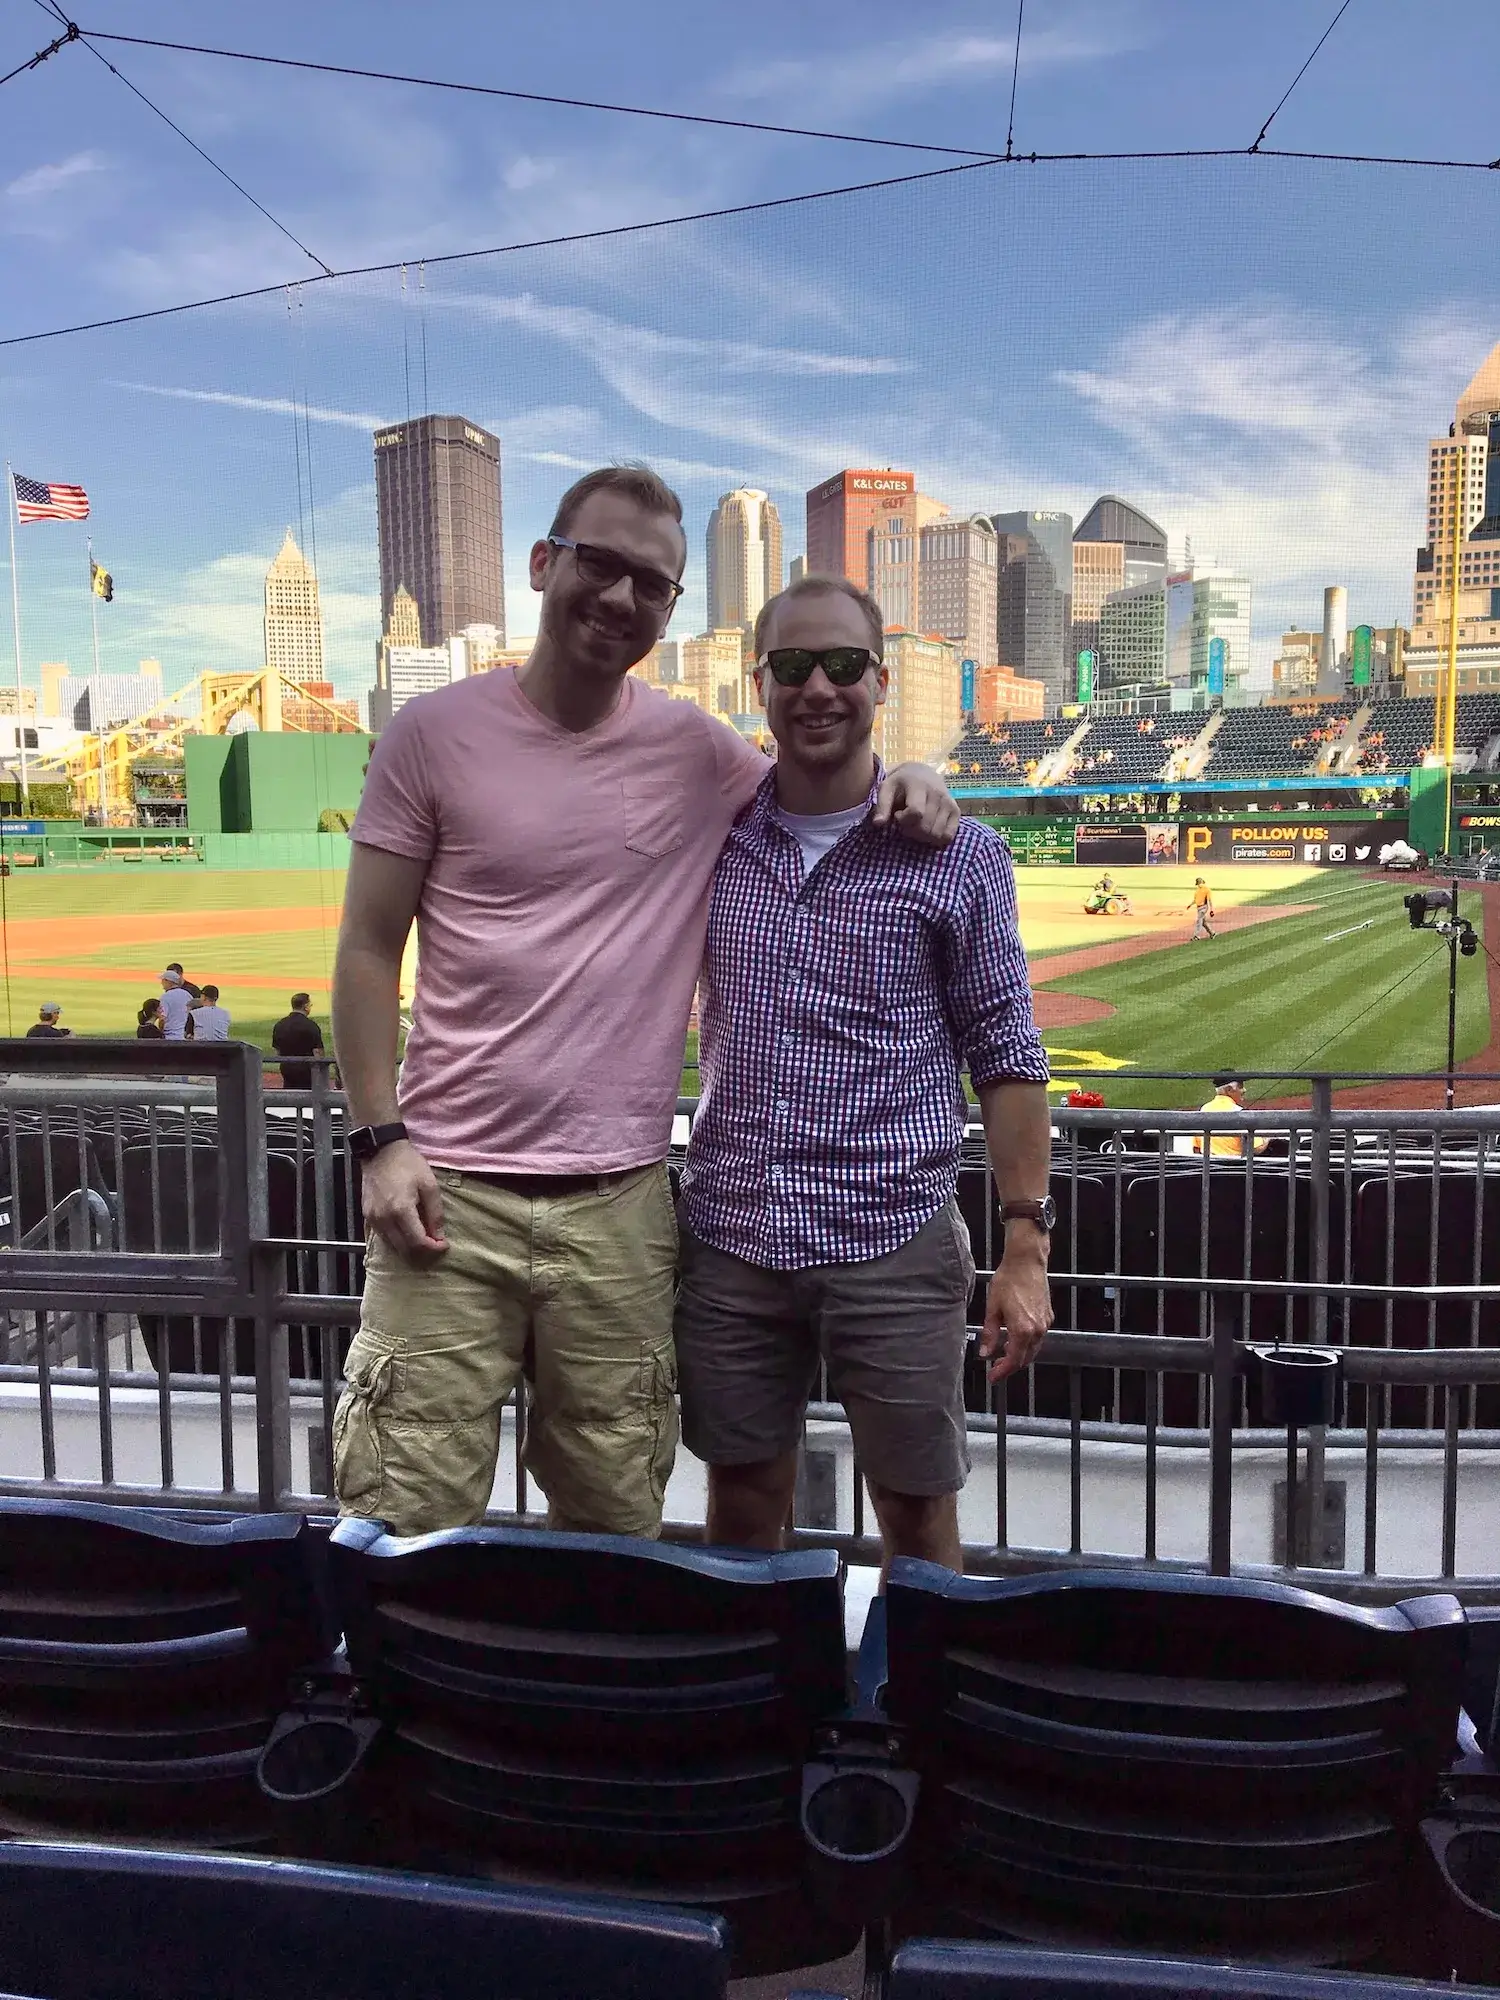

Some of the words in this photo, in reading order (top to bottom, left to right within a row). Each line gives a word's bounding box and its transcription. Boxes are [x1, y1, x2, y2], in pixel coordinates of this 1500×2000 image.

[464, 426, 485, 446] UPMC
[853, 479, 872, 489] K&L
[874, 480, 907, 491] GATES
[1042, 512, 1060, 521] PNC
[1232, 828, 1299, 840] FOLLOW
[1302, 828, 1329, 840] US:
[1186, 826, 1213, 863] P
[1235, 848, 1291, 859] pirates.com
